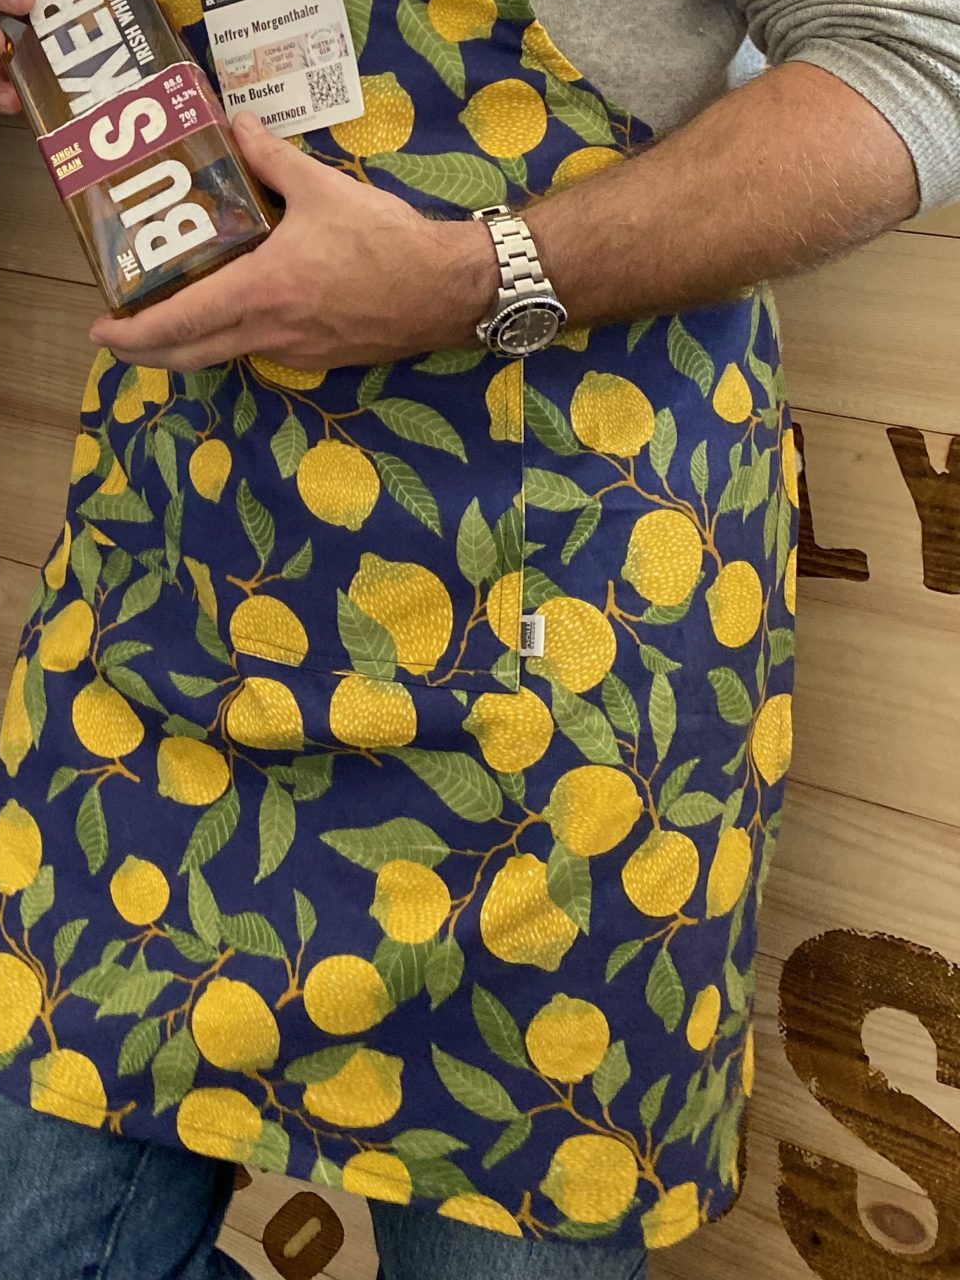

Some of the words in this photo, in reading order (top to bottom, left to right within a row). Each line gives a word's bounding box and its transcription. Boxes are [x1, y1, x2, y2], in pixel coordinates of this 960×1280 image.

[213, 26, 249, 46] Jeffrey
[251, 4, 320, 34] Morgenthaler
[124, 24, 155, 66] IRISH
[171, 88, 198, 105] 44.3%
[227, 91, 247, 106] The
[249, 82, 285, 101] Busker
[178, 107, 197, 123] 700
[260, 105, 307, 126] BARTENDER
[50, 142, 81, 165] SINGLE
[56, 156, 83, 178] GRAIN
[116, 248, 142, 281] THE
